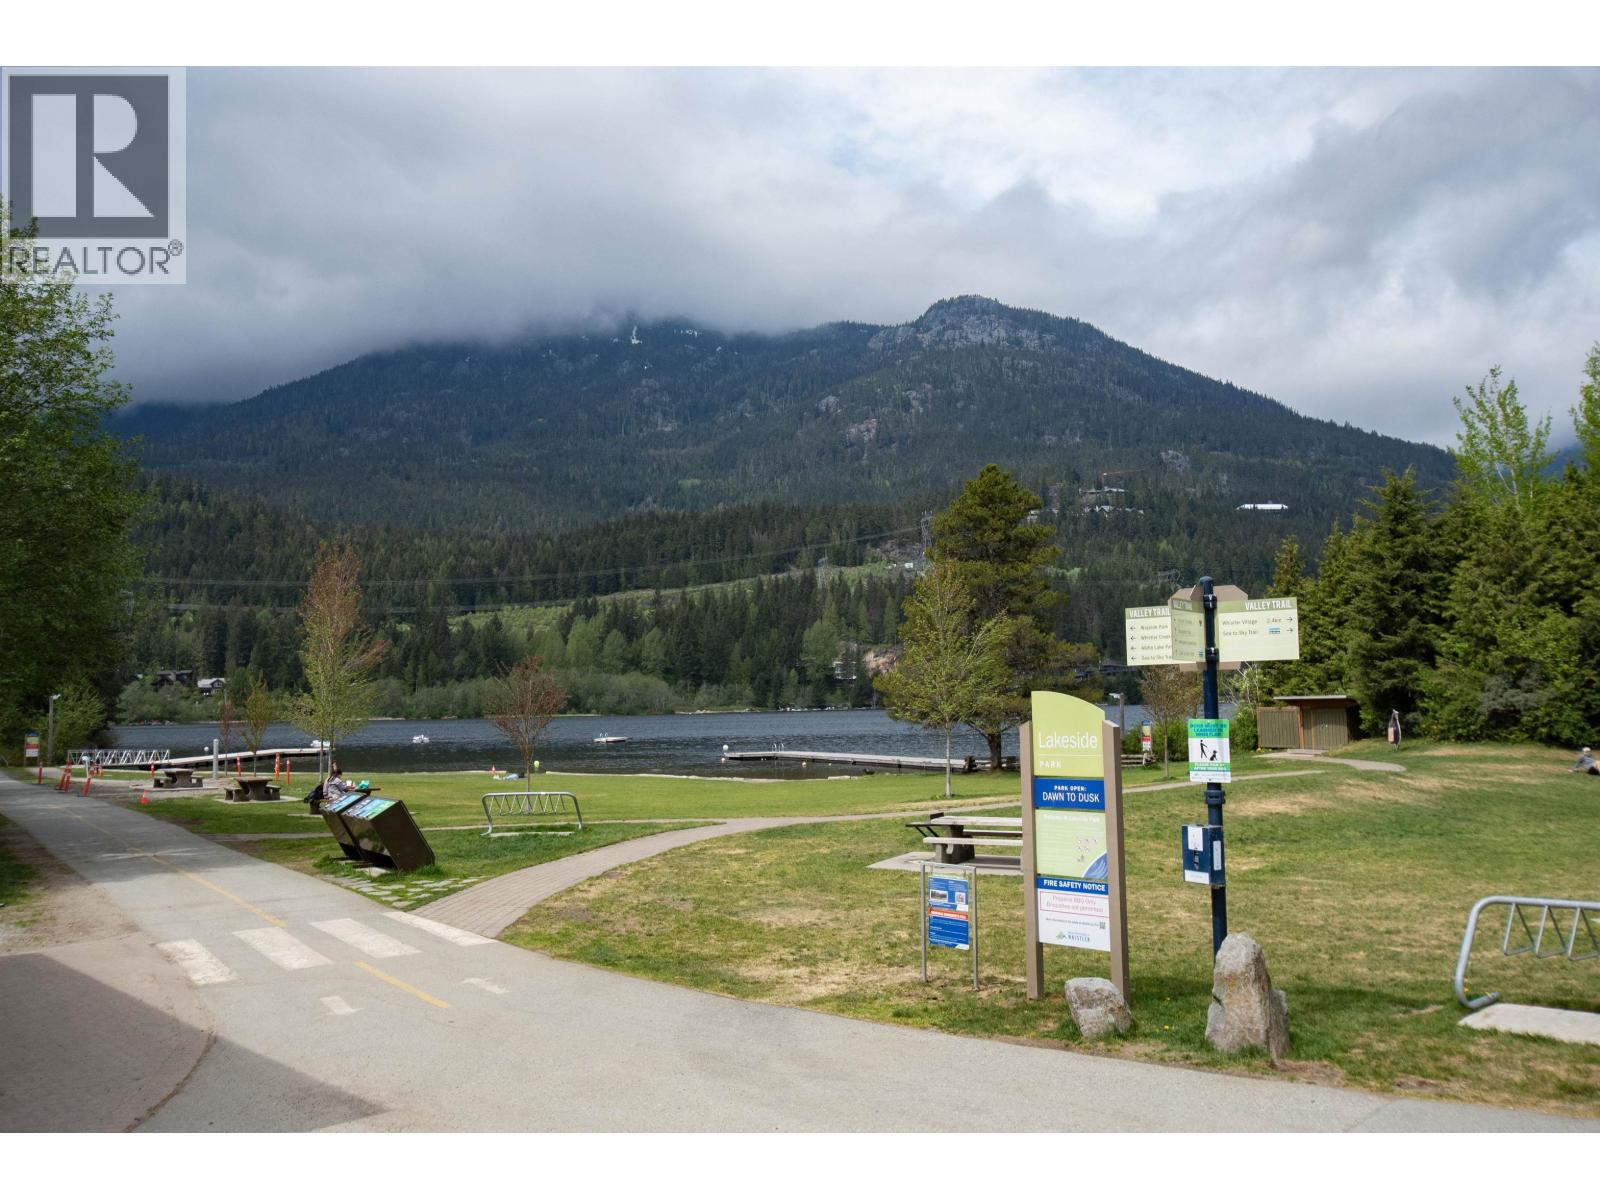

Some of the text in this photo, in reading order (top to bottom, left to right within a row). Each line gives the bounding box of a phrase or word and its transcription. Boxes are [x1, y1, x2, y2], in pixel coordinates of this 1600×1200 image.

[1245, 599, 1292, 611] VALLEY TRAIL
[1129, 607, 1171, 618] VALLEY TRAIL
[1038, 731, 1098, 749] Lakeside
[1039, 760, 1062, 769] PARK
[1042, 791, 1100, 803] DAWN TO DUSK
[1043, 879, 1106, 892] FIRE SAFETY NOTICE
